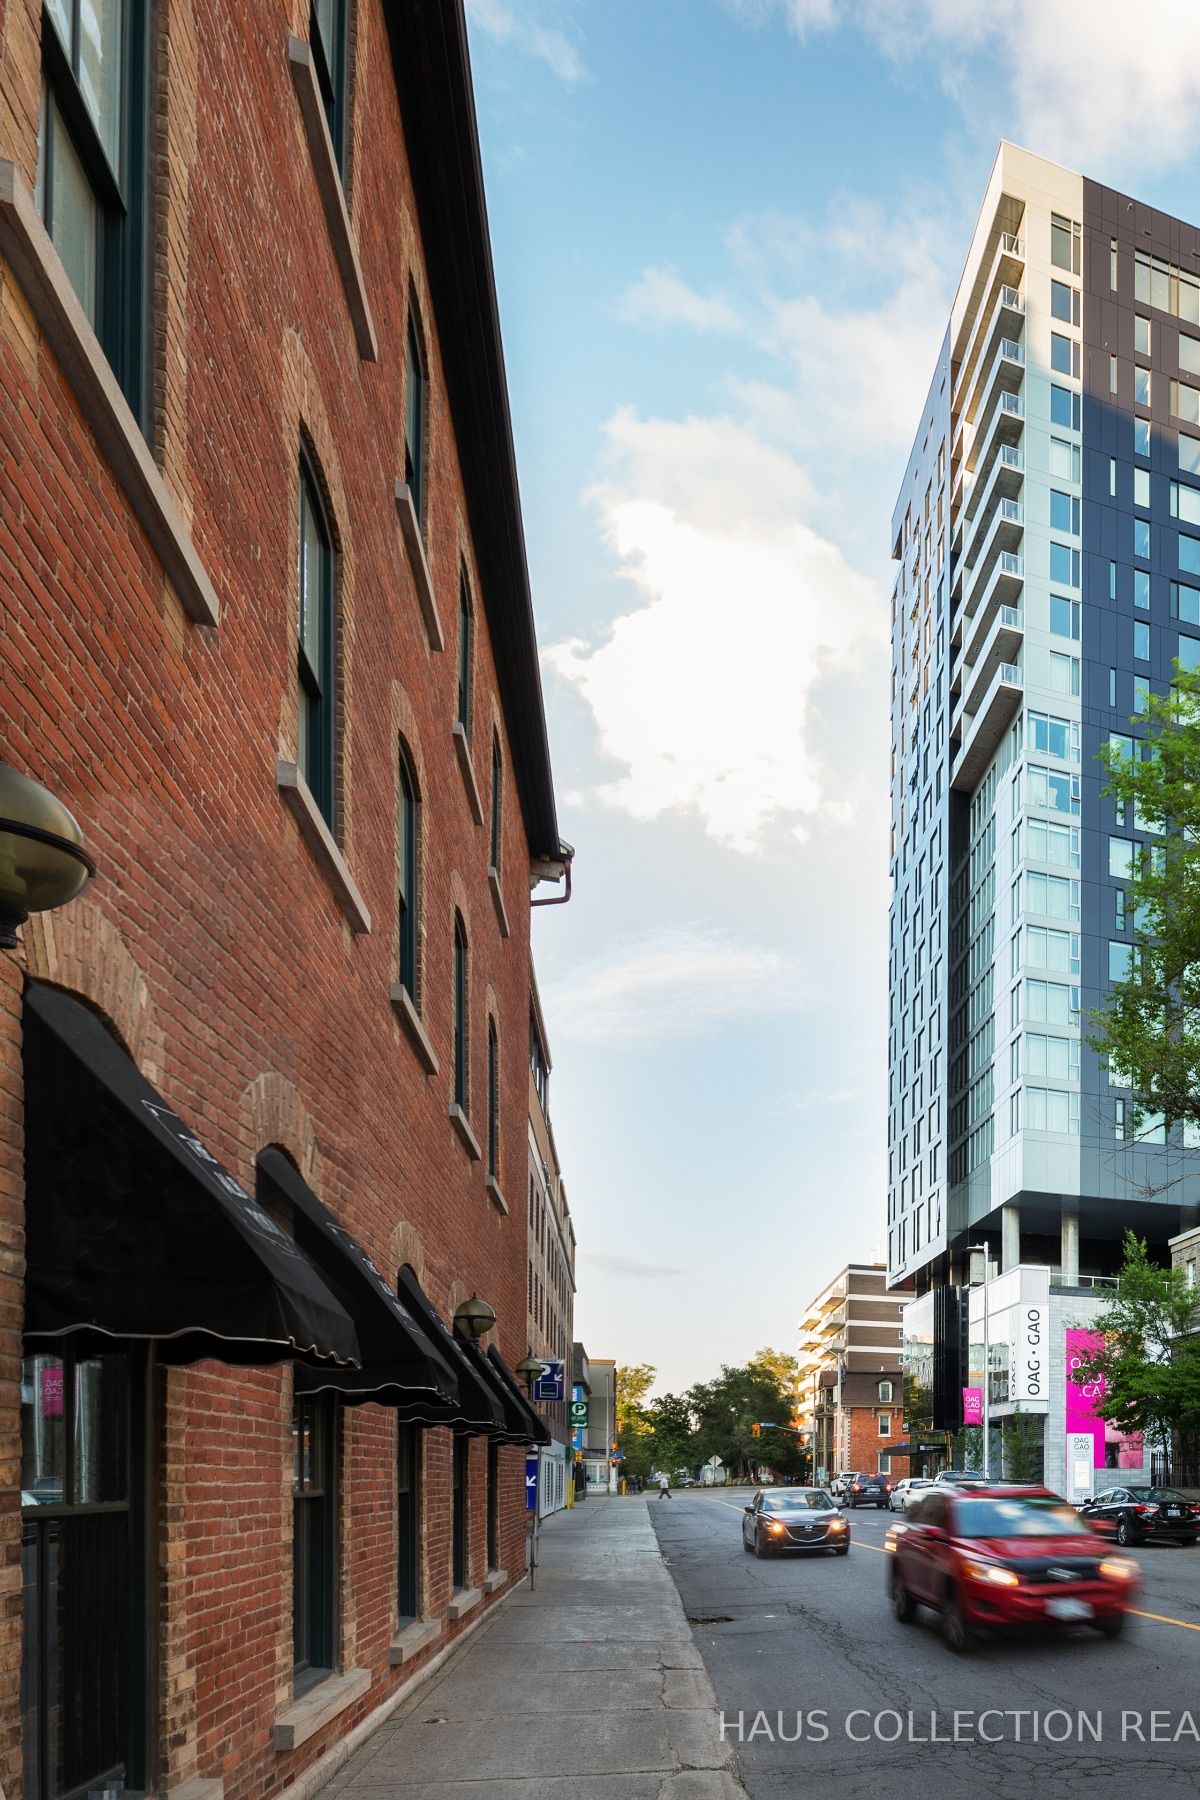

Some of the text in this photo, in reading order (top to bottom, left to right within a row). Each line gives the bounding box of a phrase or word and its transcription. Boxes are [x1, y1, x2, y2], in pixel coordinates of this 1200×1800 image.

[1028, 1310, 1040, 1345] GAO
[1028, 1360, 1040, 1396] OAG
[1079, 1386, 1102, 1397] .CA
[576, 1405, 584, 1413] P
